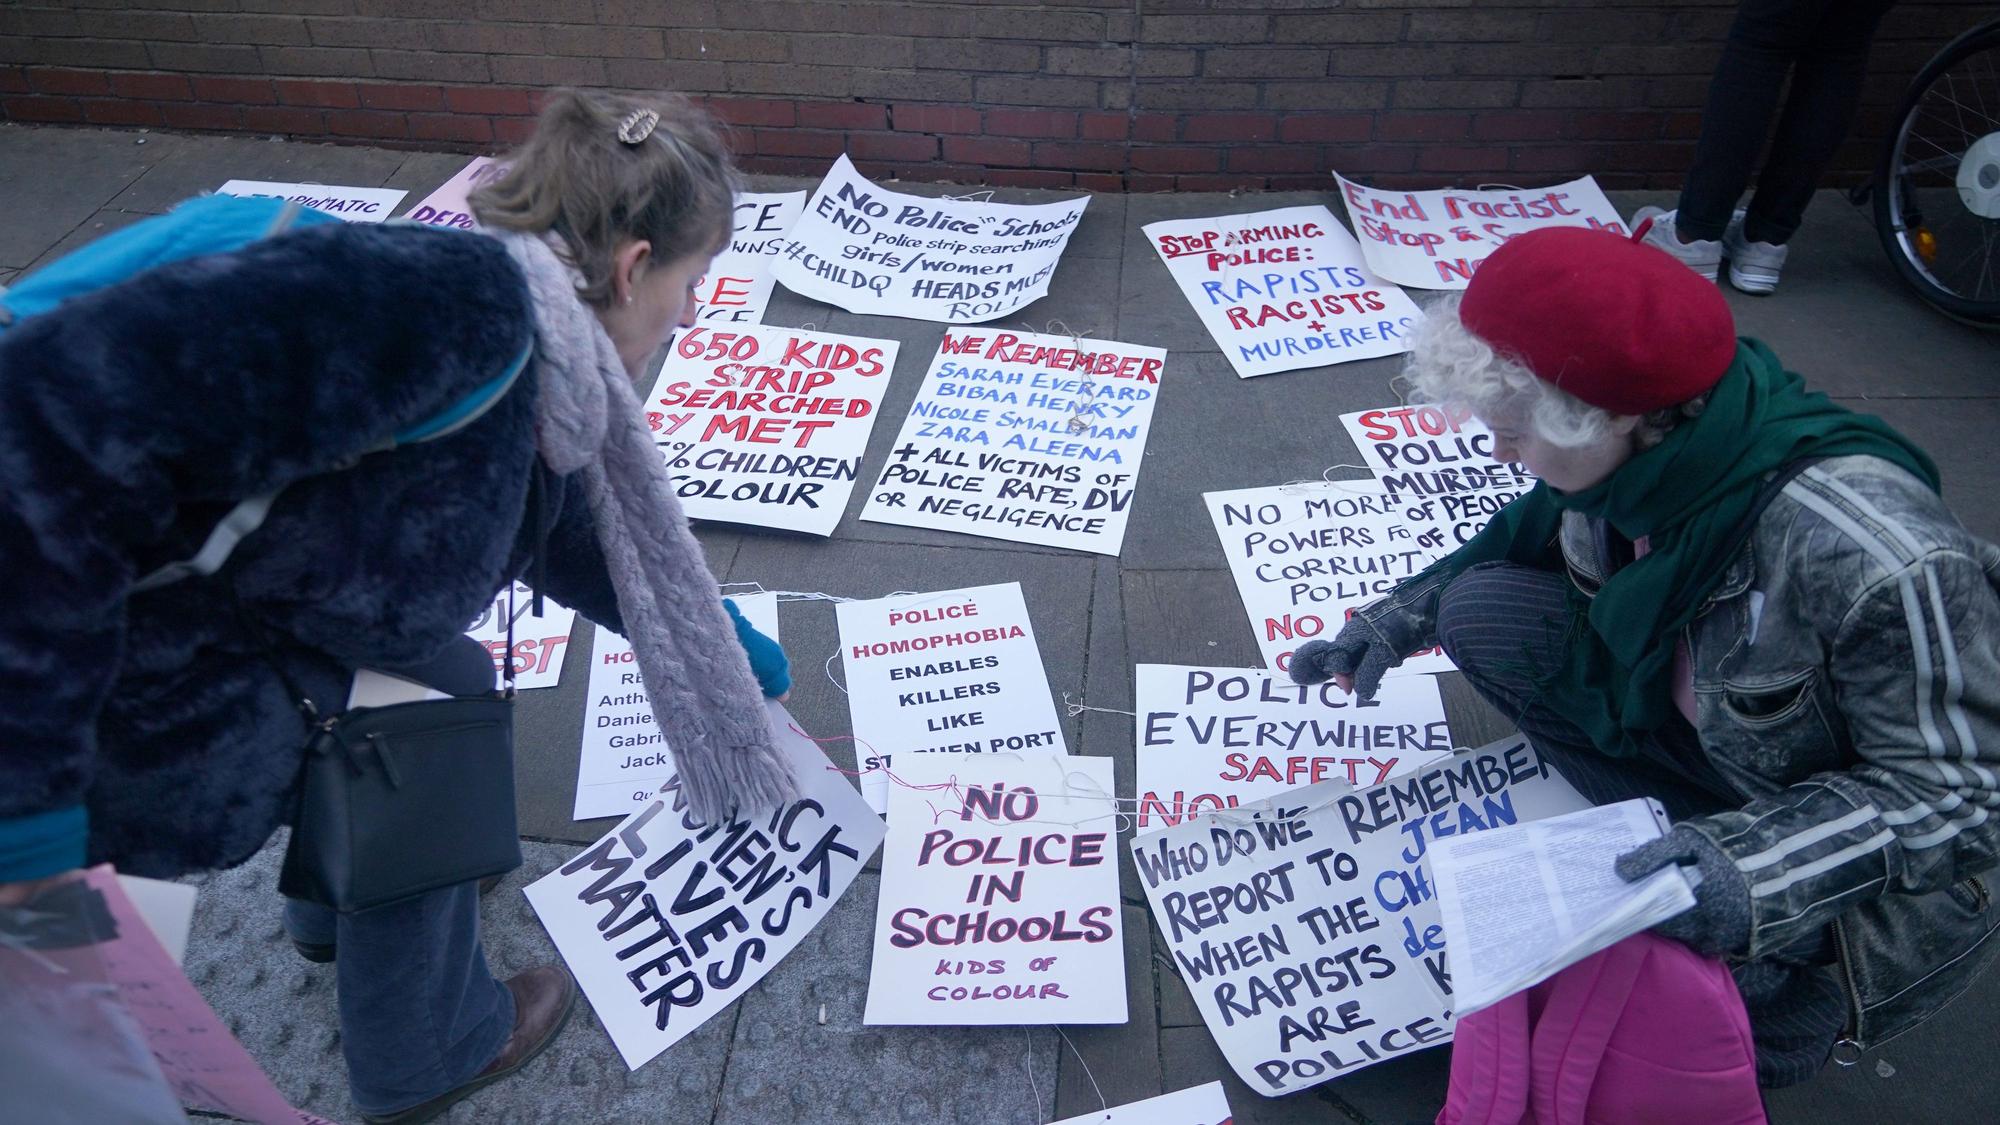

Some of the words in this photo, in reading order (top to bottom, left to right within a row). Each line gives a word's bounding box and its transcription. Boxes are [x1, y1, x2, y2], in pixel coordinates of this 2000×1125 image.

[1344, 180, 1430, 221] End
[816, 194, 872, 235] END
[926, 239, 967, 253] strip
[969, 232, 1065, 255] searching
[894, 205, 980, 235] Police
[978, 216, 997, 225] in
[993, 210, 1081, 237] Schools
[1224, 222, 1325, 247] ARMING
[1360, 215, 1445, 257] Stop
[911, 279, 1000, 300] HEADS
[1201, 266, 1366, 306] RAPISTS
[1226, 290, 1386, 331] RACISTS
[677, 327, 760, 361] 650
[781, 337, 884, 378] KIDS
[941, 333, 986, 354] WE
[984, 333, 1164, 385] REMEMBER
[705, 363, 836, 395] STRIP
[936, 362, 1024, 386] SARAH
[1031, 372, 1152, 402] EVERARD
[660, 381, 873, 419] SEARCHED
[911, 400, 988, 423] NICOLE
[936, 383, 1018, 406] BIBAA
[1027, 392, 1135, 418] HENRY
[645, 411, 696, 435] BY
[699, 413, 836, 449] MET
[1358, 403, 1473, 441] STOP
[916, 422, 990, 446] ZARA
[1003, 433, 1123, 465] ALEENA
[695, 448, 862, 481] CHILDREN
[922, 447, 970, 468] ALL
[979, 453, 1081, 483] VICTIMS
[879, 464, 985, 494] POLICE
[1082, 487, 1134, 513] DV
[1406, 500, 1436, 522] OF
[1439, 490, 1524, 522] PEOP
[918, 495, 1106, 536] NEGLIGENCE
[1222, 502, 1282, 527] NO
[1305, 494, 1396, 520] MORE
[1244, 526, 1375, 558] POWERS
[1416, 527, 1446, 548] OF
[1255, 550, 1423, 583] CORRUPT
[889, 603, 978, 626] POLICE
[1265, 613, 1325, 642] NO
[852, 625, 1026, 659] HOMOPHOBIA
[889, 655, 1000, 681] ENABLES
[898, 681, 1001, 707] KILLERS
[597, 712, 657, 729] Danie
[927, 711, 985, 732] LIKE
[1144, 712, 1454, 752] EVERYWHERE
[620, 752, 667, 769] Jack
[989, 731, 1056, 754] PORT
[1219, 752, 1400, 786] SAFETY
[961, 782, 1039, 822] NO
[1401, 790, 1518, 864] JEAN
[918, 829, 1107, 867] POLICE
[1135, 837, 1208, 888] WHO
[1211, 827, 1257, 866] DO
[1253, 806, 1314, 851] WE
[618, 800, 767, 990] LIVES
[966, 870, 1025, 906] IN
[1162, 861, 1295, 943] REPORT
[1307, 848, 1359, 887] TO
[560, 836, 704, 1032] MATTER
[890, 906, 1113, 948] SCHOOLS
[1176, 923, 1291, 983] WHEN
[1298, 896, 1380, 945] THE
[935, 958, 1006, 976] KIDS
[1028, 956, 1058, 973] OF
[927, 983, 1069, 1001] COLOUR
[1213, 944, 1396, 1026] RAPISTS
[1279, 1000, 1376, 1052] ARE
